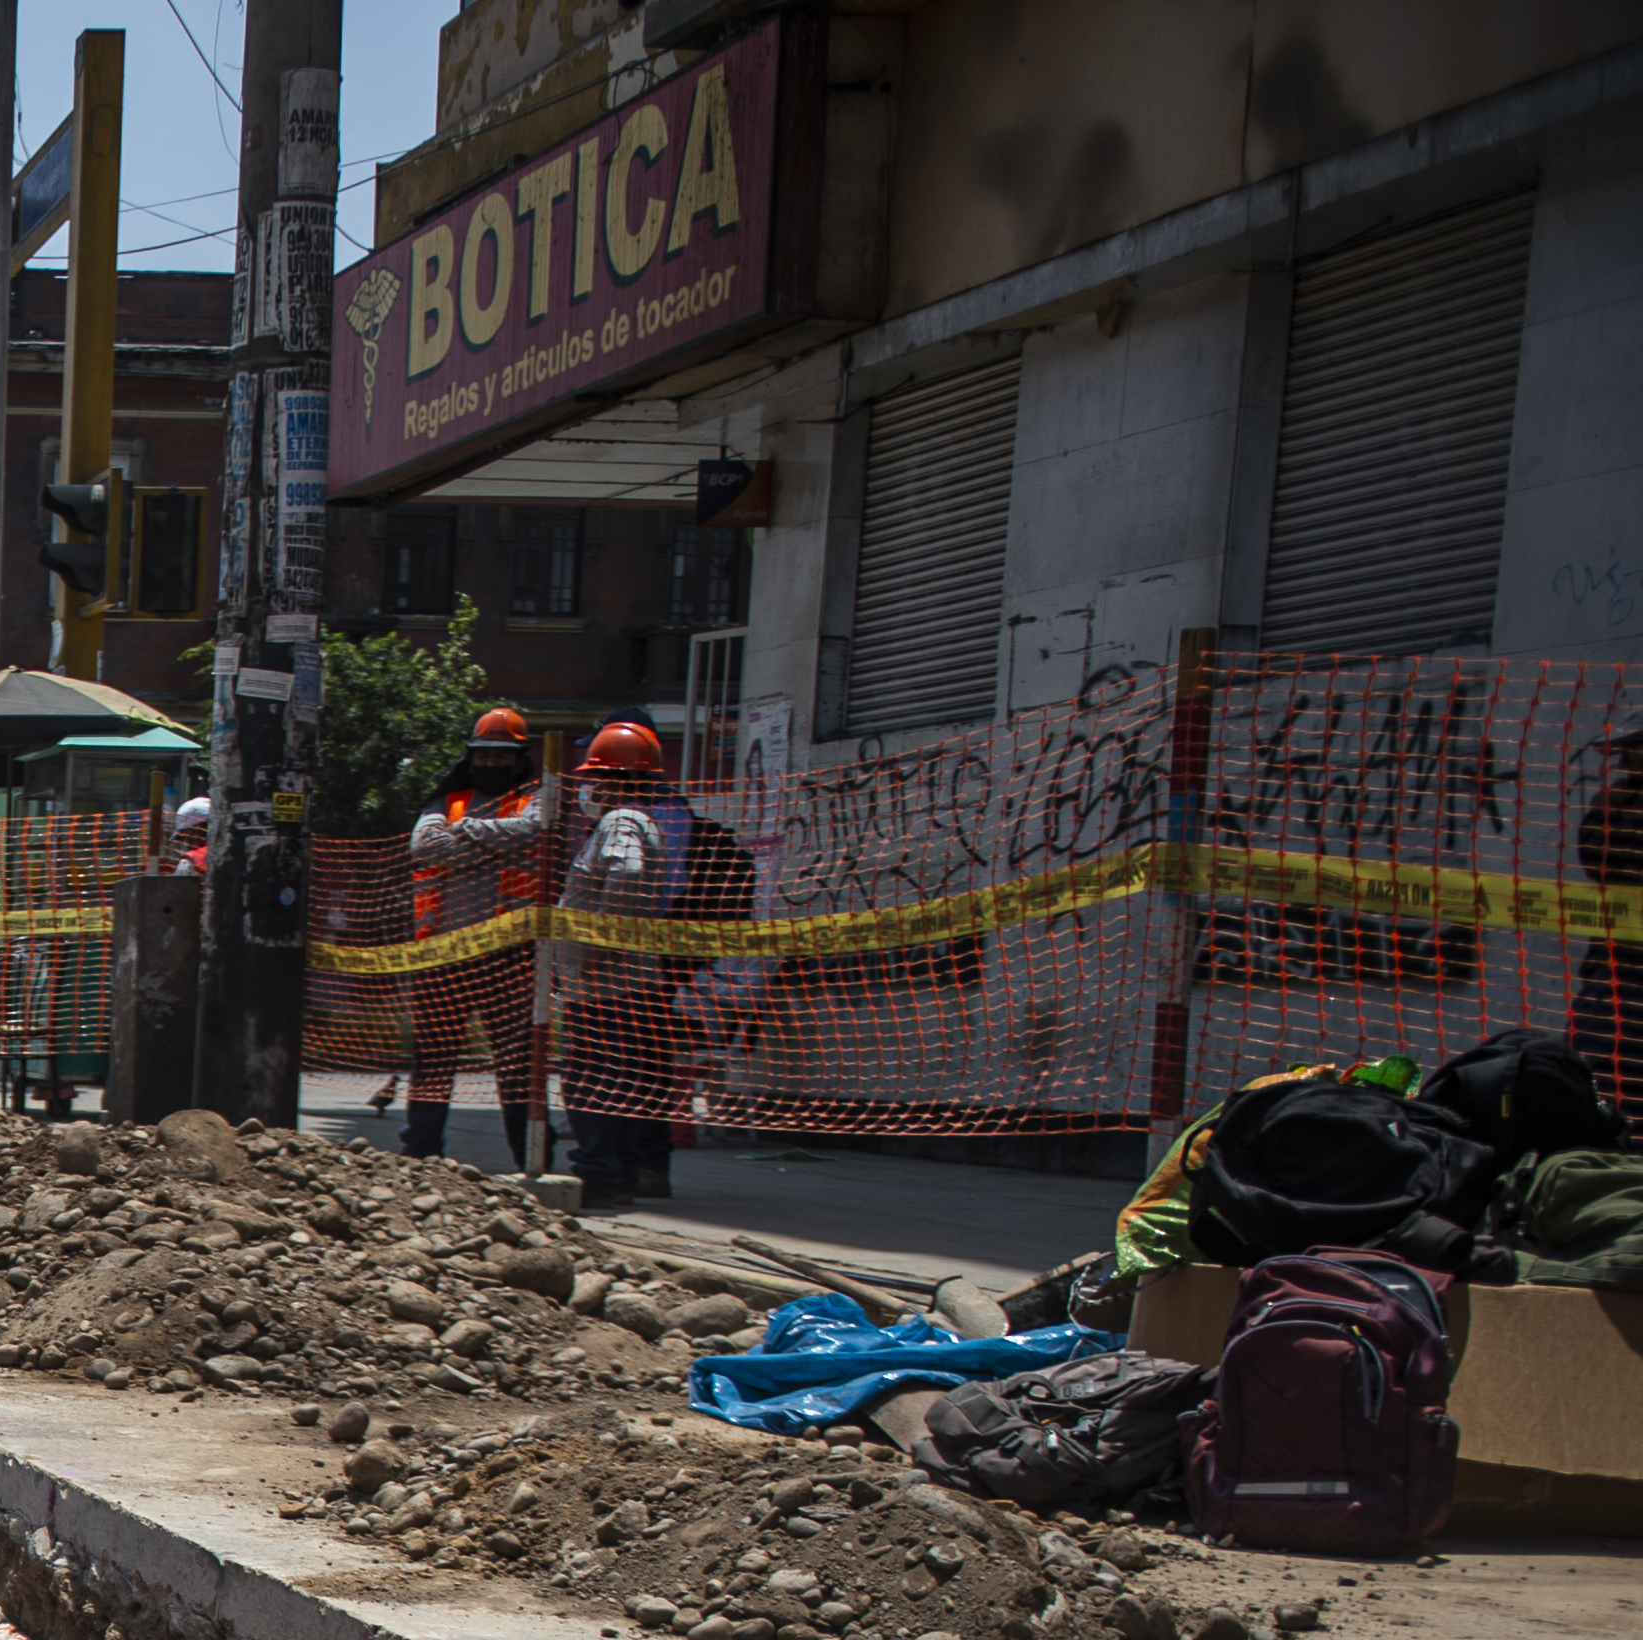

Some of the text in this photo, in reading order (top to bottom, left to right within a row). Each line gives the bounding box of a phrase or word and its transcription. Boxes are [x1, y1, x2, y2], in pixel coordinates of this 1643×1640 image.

[407, 63, 740, 379] BOTICA
[404, 265, 737, 441] Regalos y articulos de tocador
[276, 795, 302, 806] GPS
